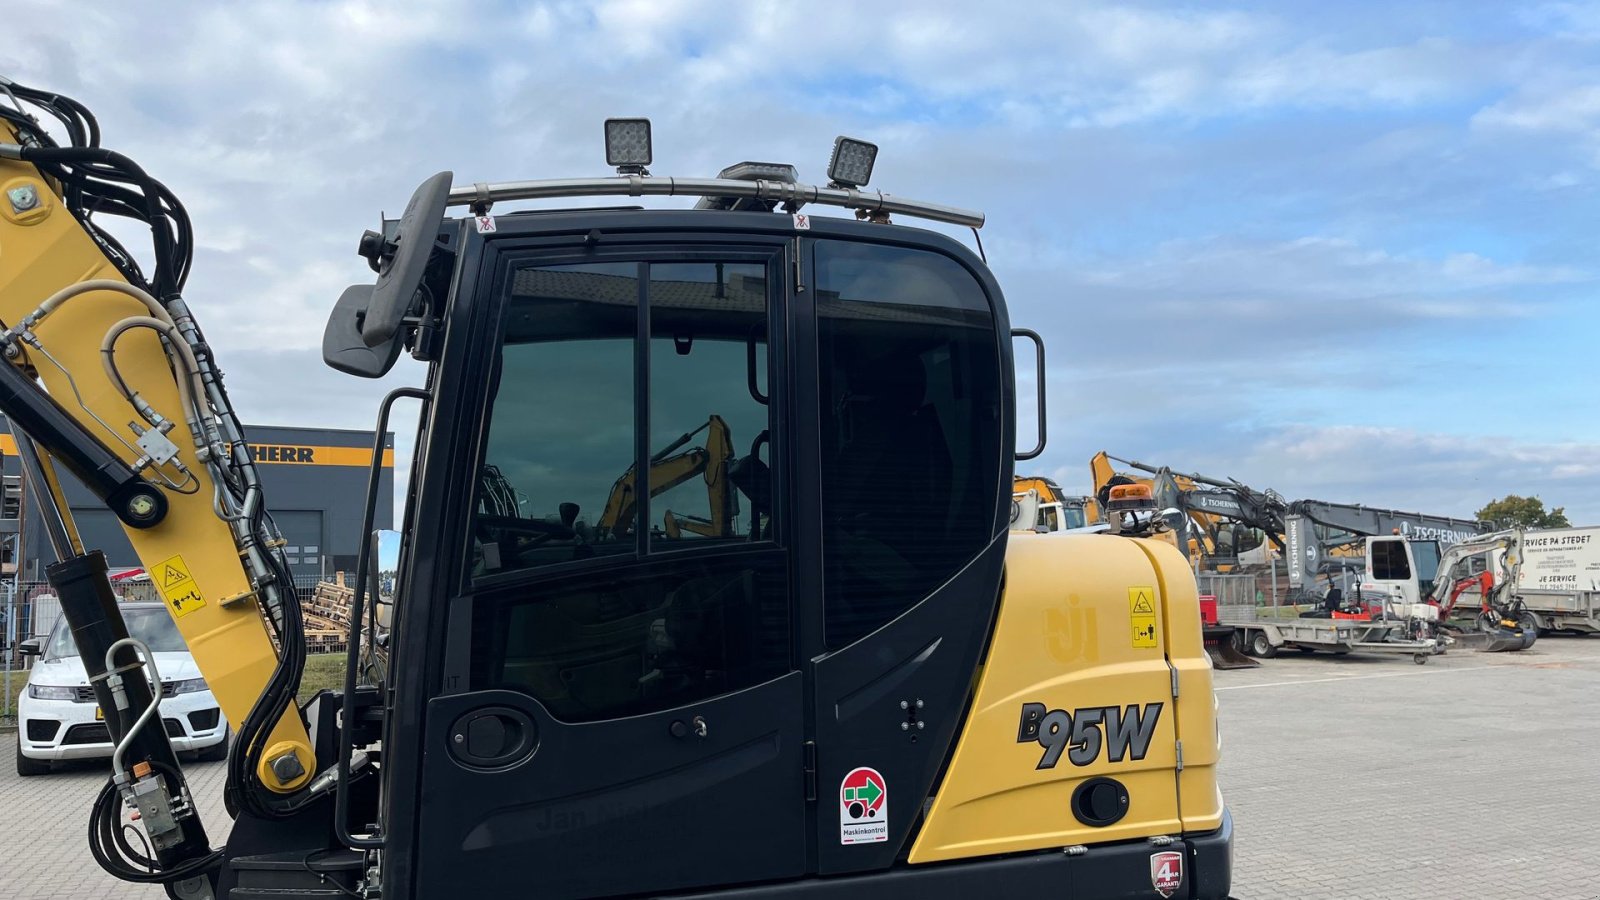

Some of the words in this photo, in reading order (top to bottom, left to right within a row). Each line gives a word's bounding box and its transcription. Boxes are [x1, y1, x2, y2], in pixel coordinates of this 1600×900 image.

[247, 446, 314, 463] HERR
[1290, 520, 1298, 568] TSCHERNING
[1562, 535, 1591, 544] STEDET
[1548, 575, 1576, 583] SERVICE
[1017, 702, 1164, 771] B95W
[843, 826, 886, 836] Maskinkontrol
[1157, 862, 1170, 881] 4
